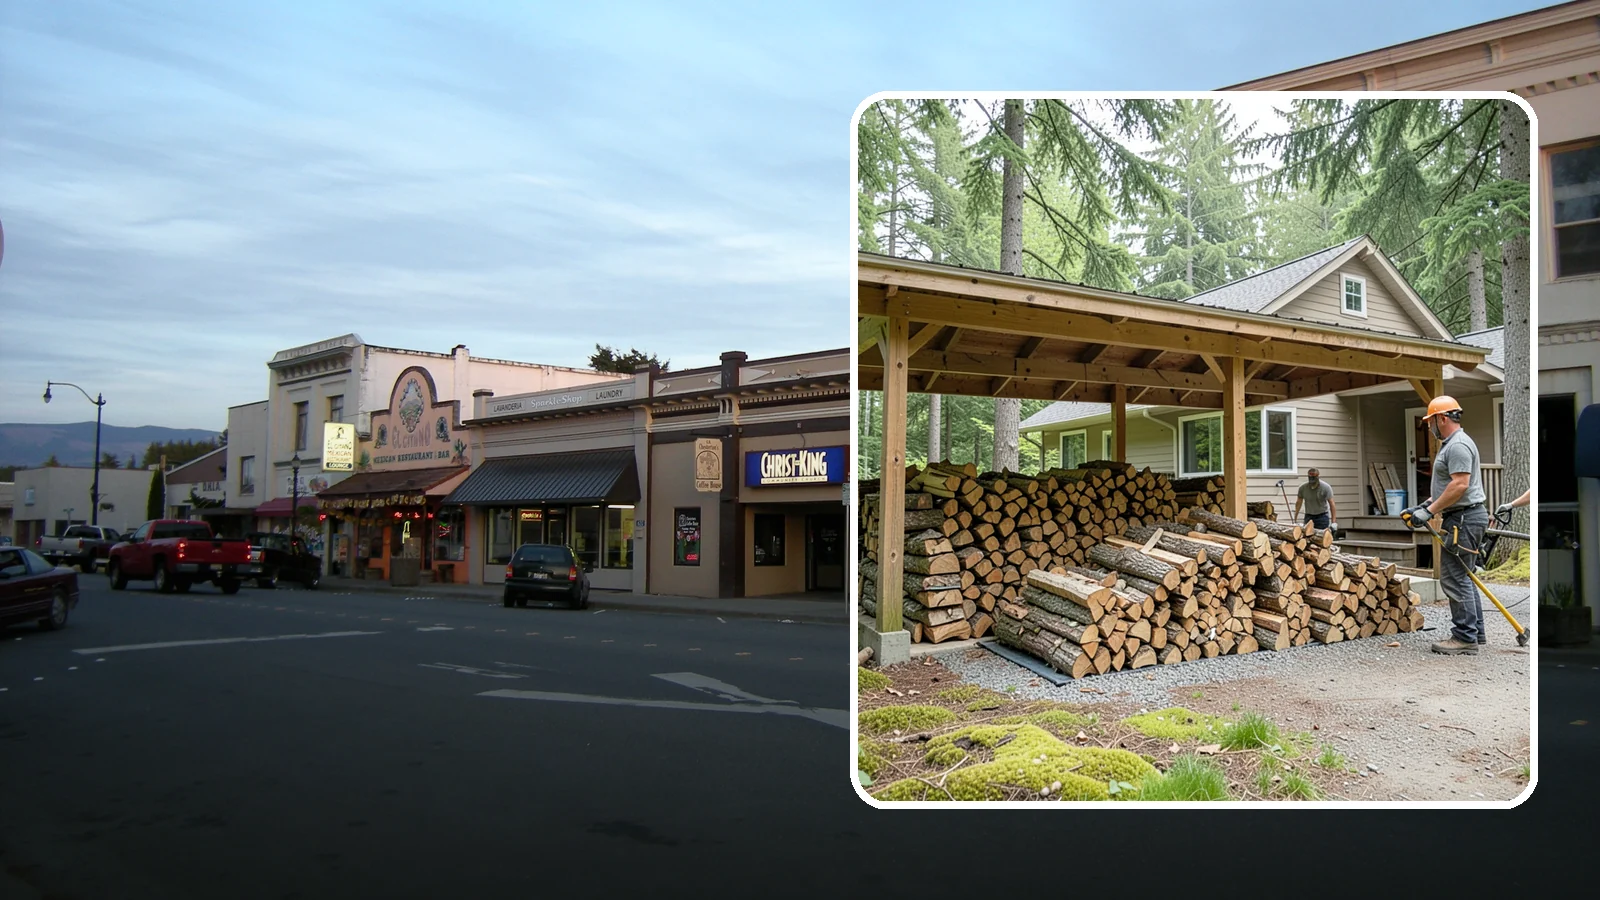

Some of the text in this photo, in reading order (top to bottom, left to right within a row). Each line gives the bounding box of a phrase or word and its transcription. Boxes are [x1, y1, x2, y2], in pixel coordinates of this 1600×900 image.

[530, 394, 582, 409] Sparkle Shop
[595, 389, 624, 400] LAUNDRY
[493, 402, 523, 413] LAVANDERIA
[373, 450, 450, 464] MEXICAN RESTAURANT BAR
[760, 450, 828, 478] CHRIST KING
